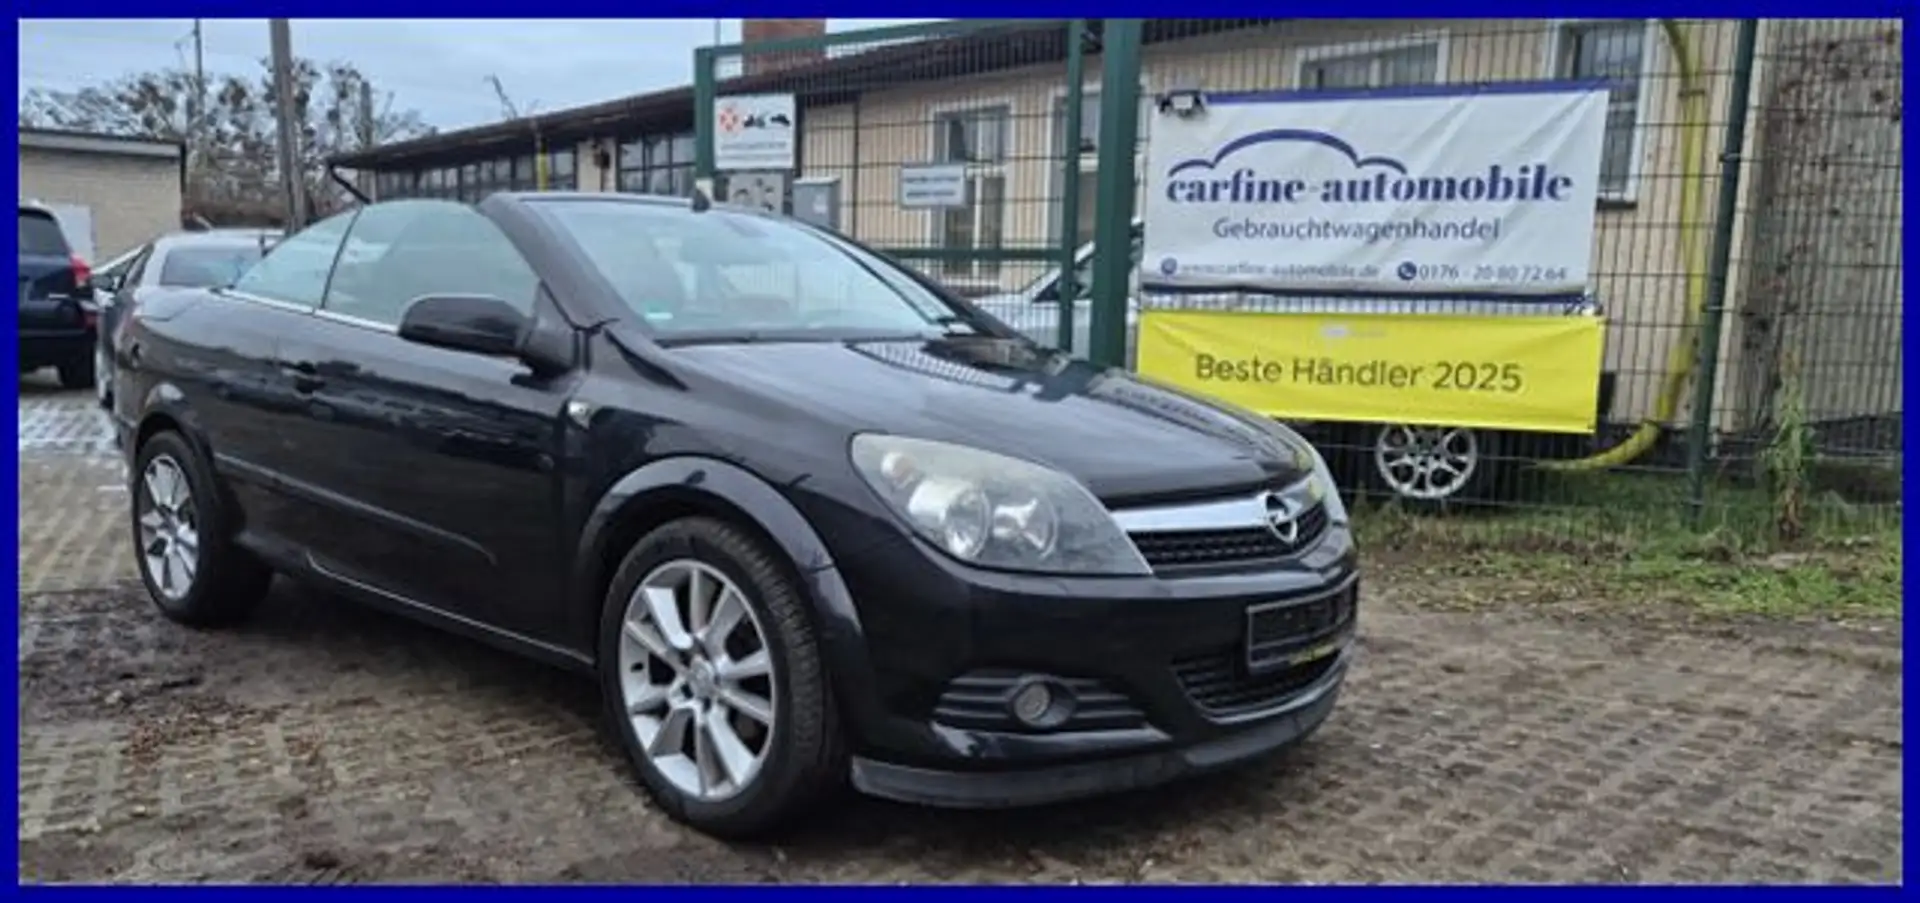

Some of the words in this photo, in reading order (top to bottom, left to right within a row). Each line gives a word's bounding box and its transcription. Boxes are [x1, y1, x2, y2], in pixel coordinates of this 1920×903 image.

[1167, 165, 1573, 202] carfine-automobile
[1213, 217, 1500, 243] Gebrauchtwagenhandel
[1418, 264, 1459, 280] 0176
[1196, 354, 1282, 382] Beste
[1293, 358, 1423, 387] Händler
[1432, 360, 1522, 392] 2025
